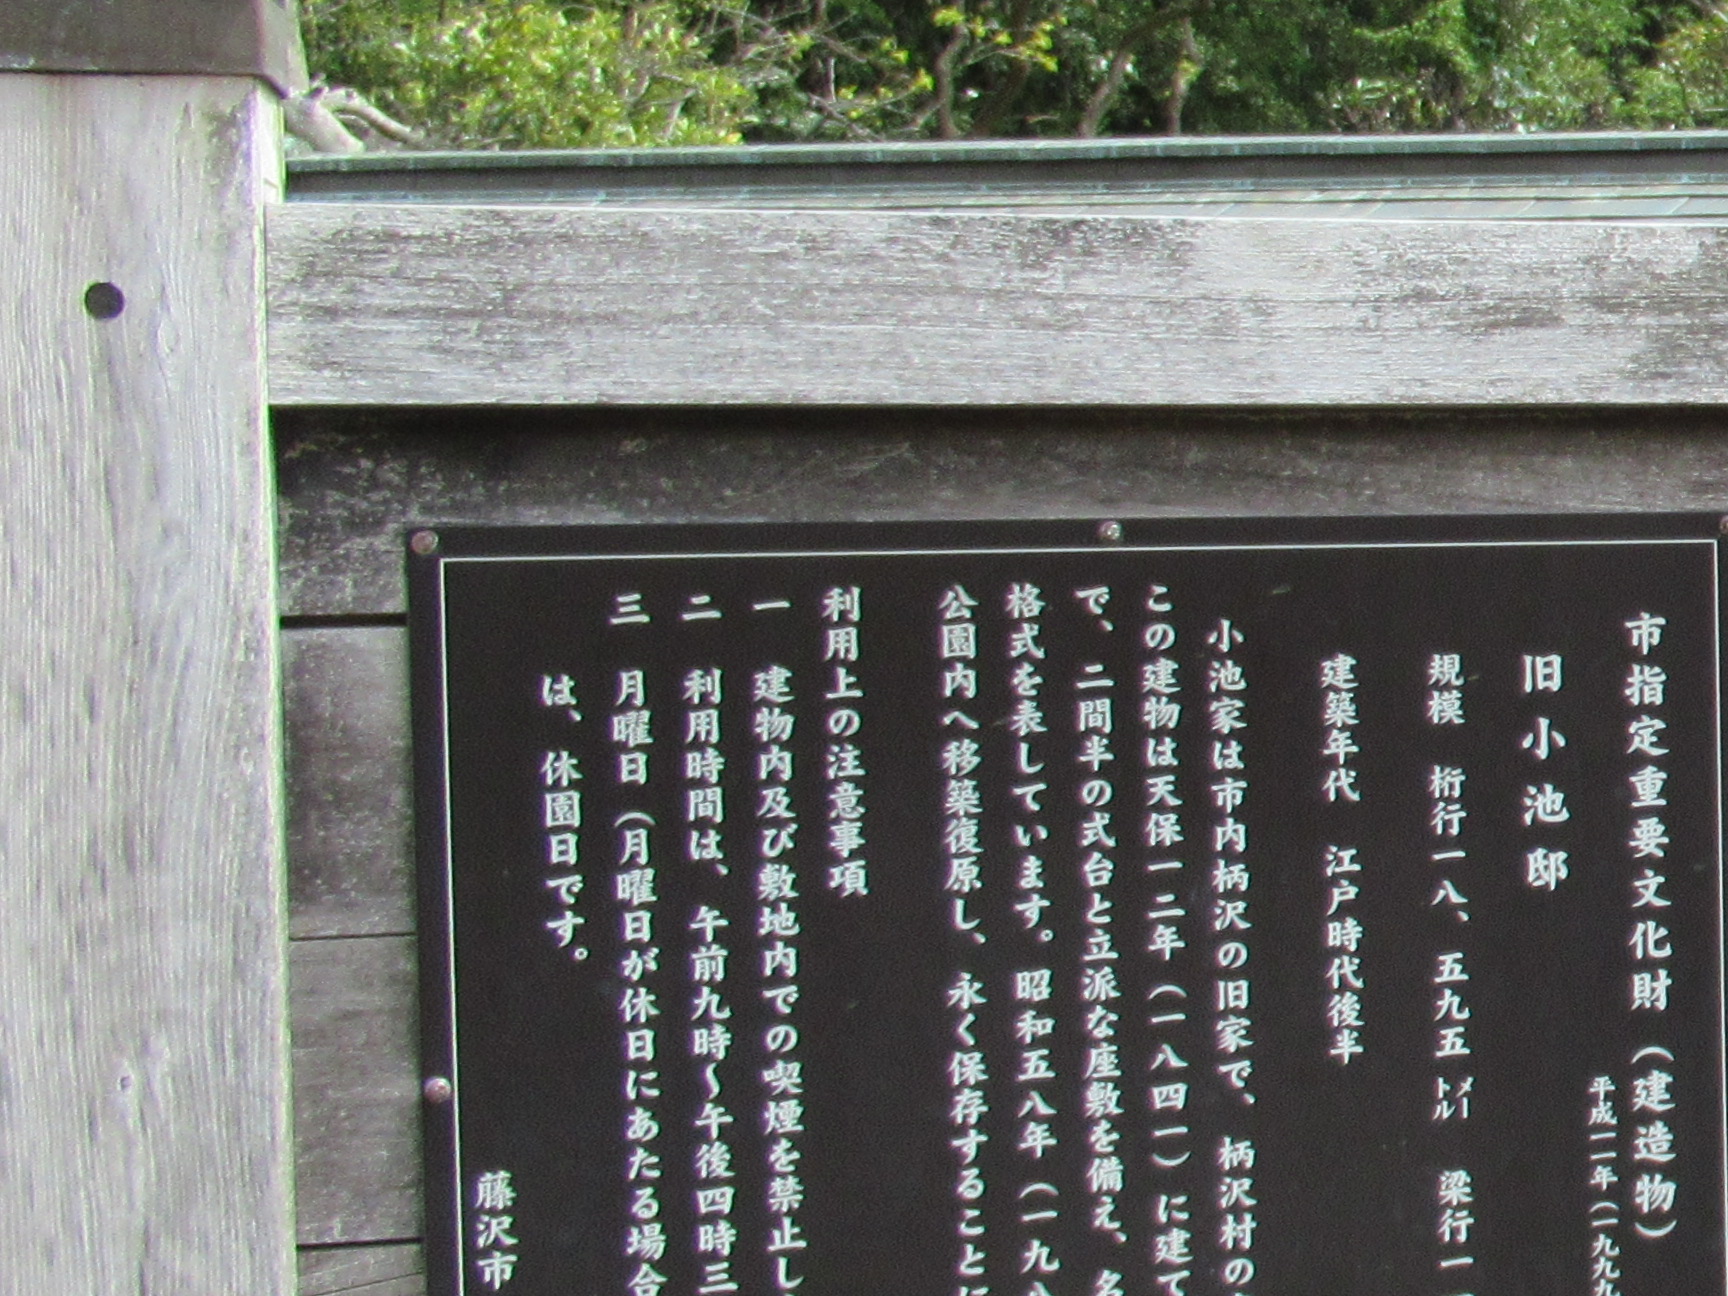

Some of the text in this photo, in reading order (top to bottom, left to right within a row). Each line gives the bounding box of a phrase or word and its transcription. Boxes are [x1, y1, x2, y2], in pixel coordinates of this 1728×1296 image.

[610, 593, 650, 625] 三
[1427, 653, 1465, 725] 規模
[823, 586, 869, 897] 利用上の注意事項
[1521, 654, 1570, 891] 旧小池邸
[1320, 653, 1365, 1065] 建築年代 江戸時代後半
[475, 1170, 519, 1290] 藤沢市
